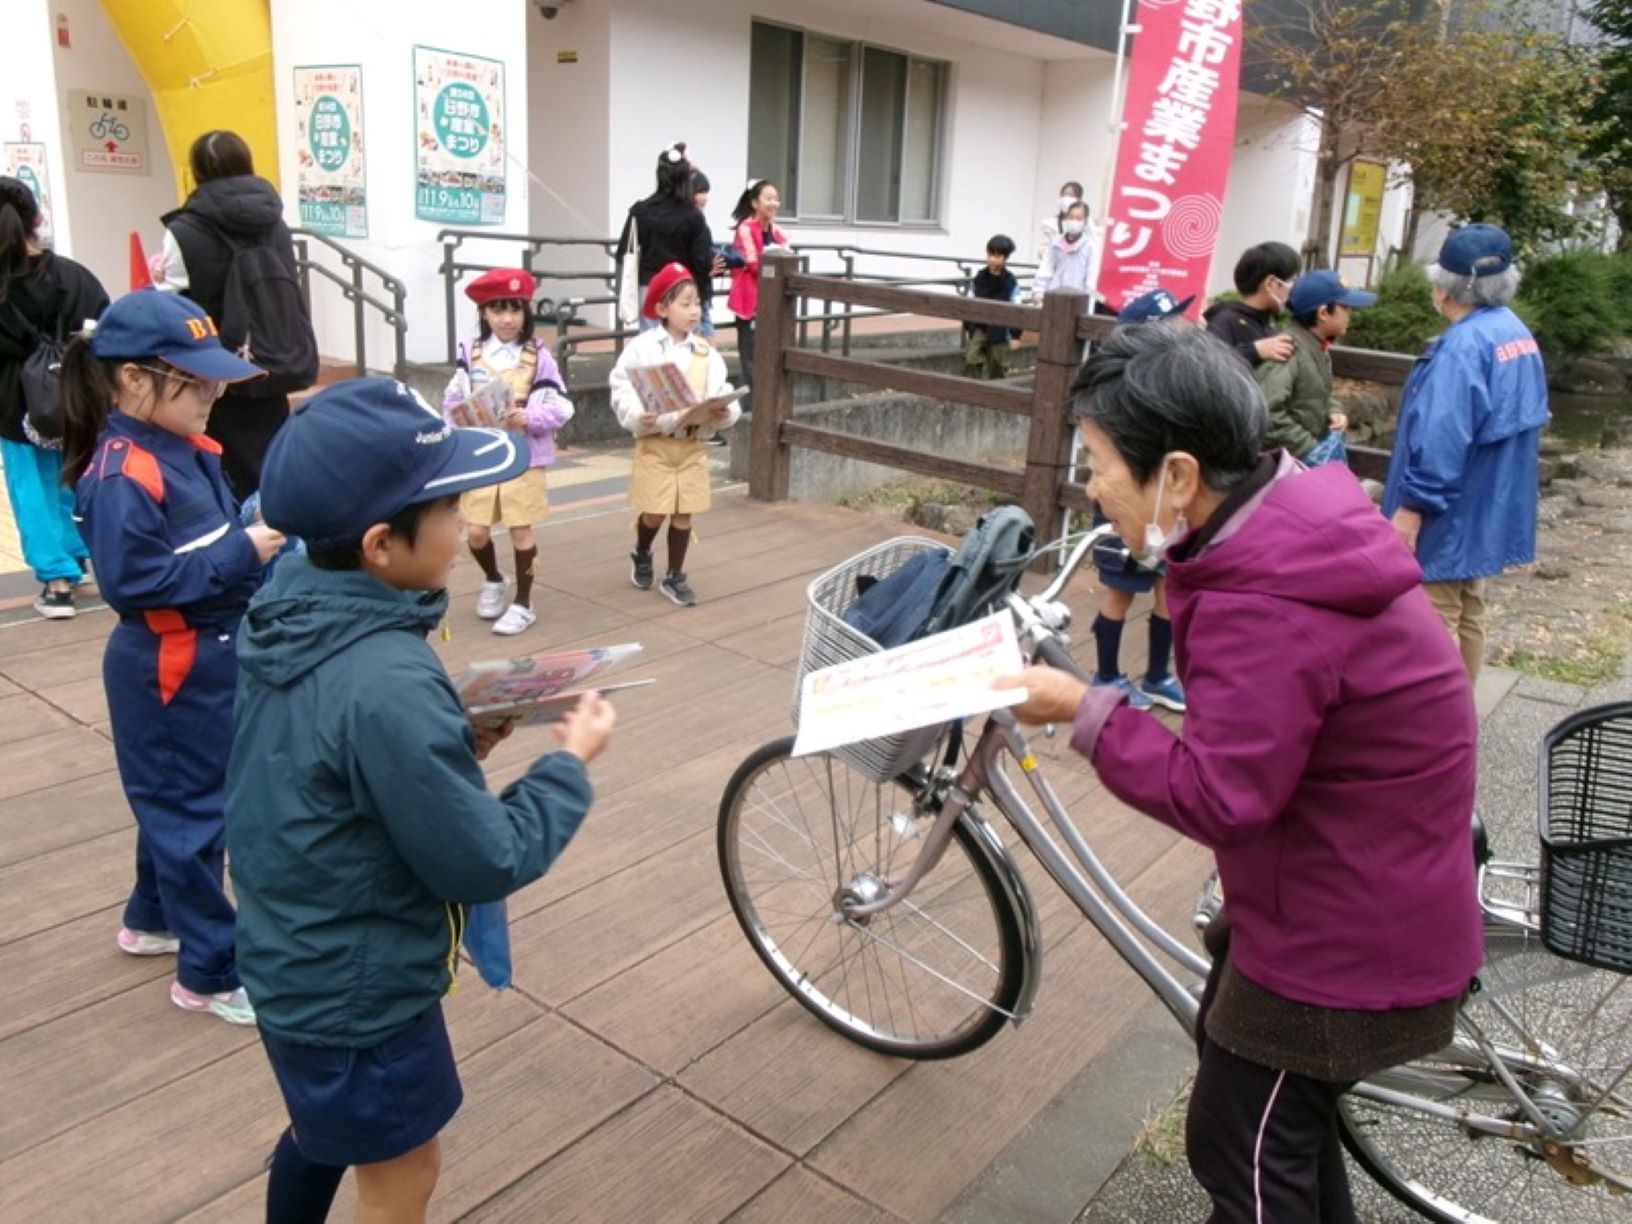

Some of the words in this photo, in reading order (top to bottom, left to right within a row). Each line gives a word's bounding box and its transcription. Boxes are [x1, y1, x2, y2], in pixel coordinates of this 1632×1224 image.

[444, 100, 480, 119] 日野市
[446, 136, 480, 154] まつり
